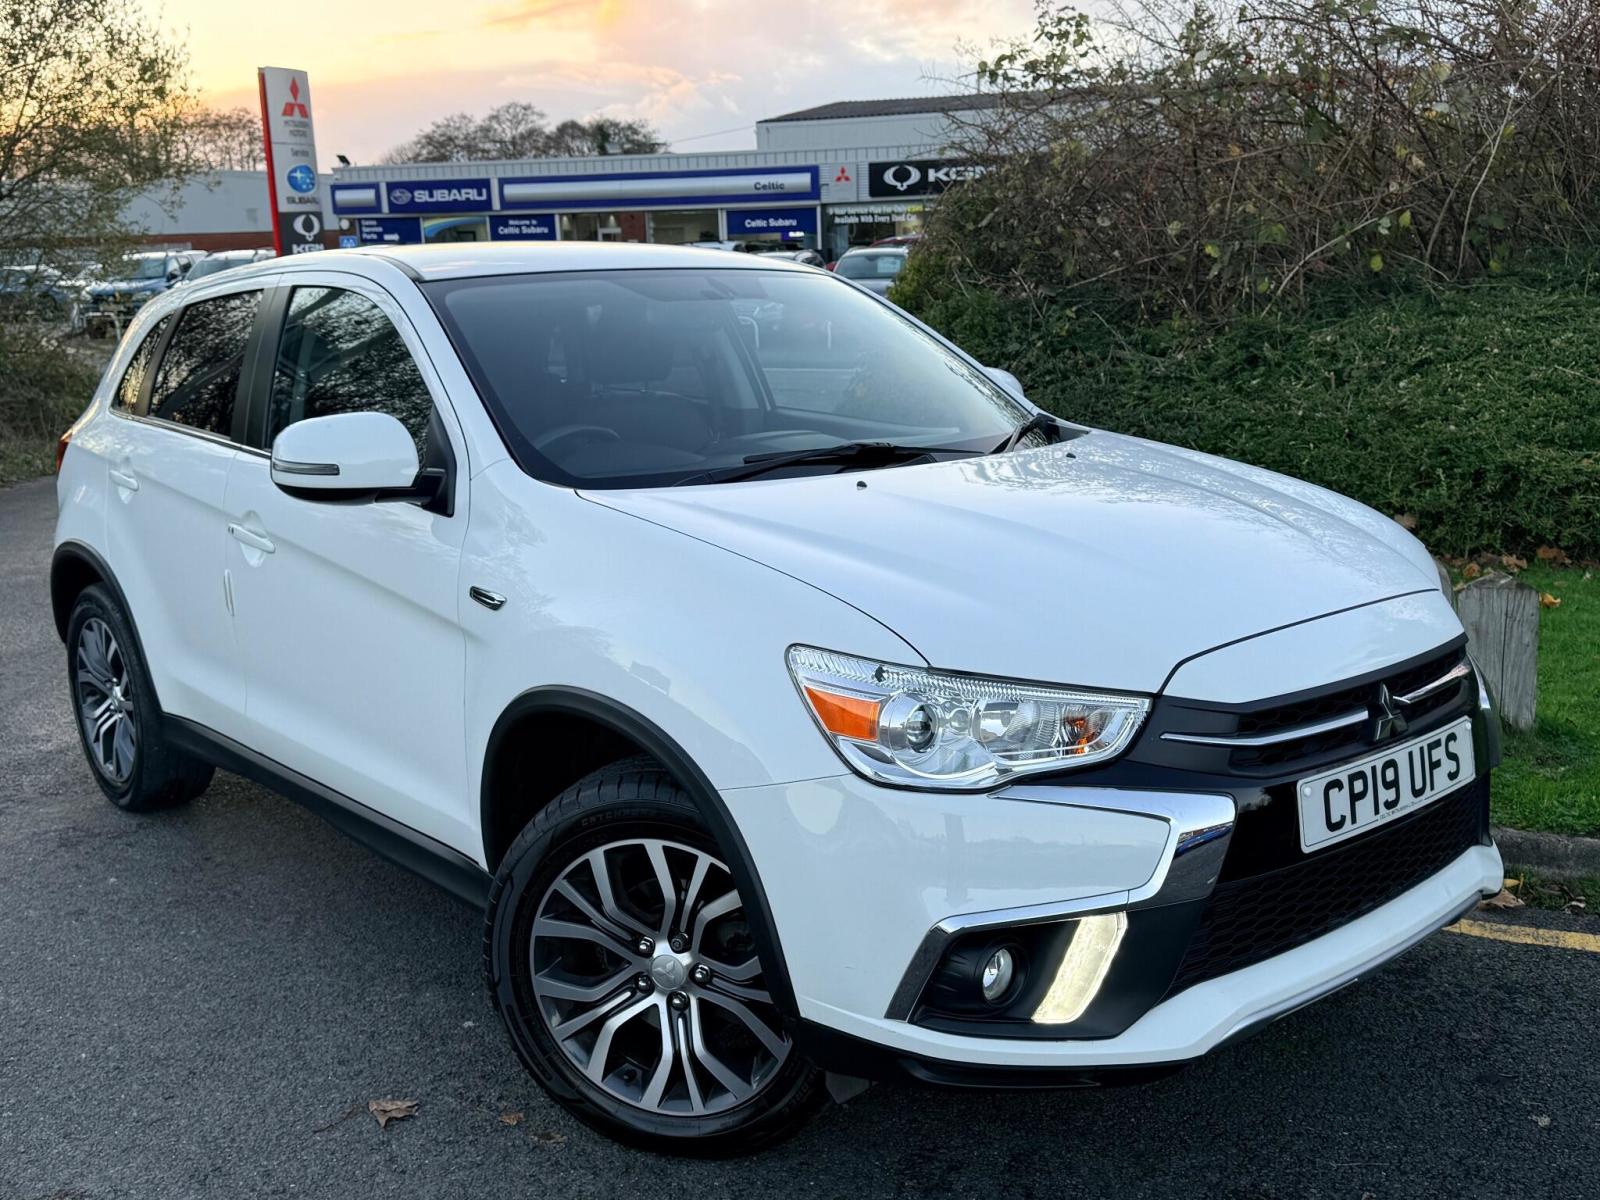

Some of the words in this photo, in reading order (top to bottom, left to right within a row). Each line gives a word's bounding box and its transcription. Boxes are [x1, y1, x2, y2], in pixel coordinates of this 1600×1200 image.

[753, 181, 785, 191] Celtic
[413, 187, 487, 203] SUBARU
[744, 219, 768, 228] Celtic
[768, 217, 798, 227] Subaru
[498, 226, 520, 235] Celtic
[521, 225, 549, 234] Subaru
[1323, 758, 1400, 833] CP19
[1408, 732, 1460, 799] UFS
